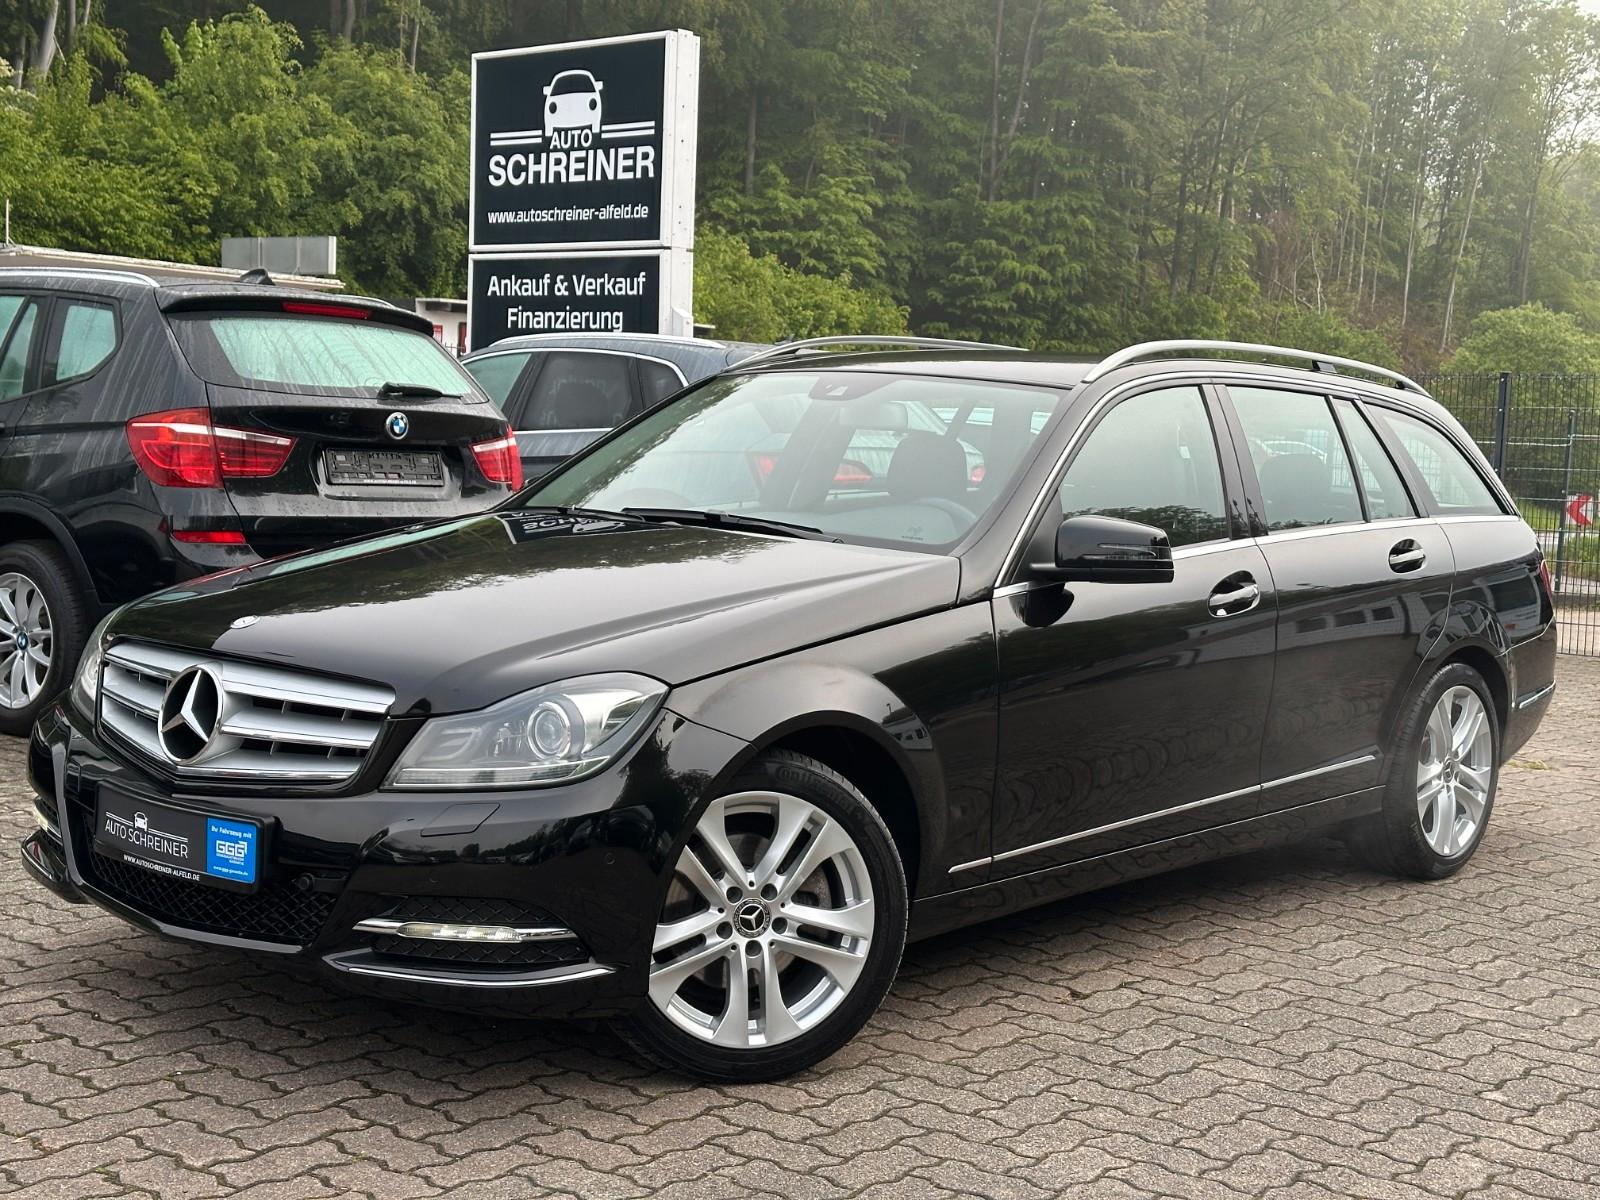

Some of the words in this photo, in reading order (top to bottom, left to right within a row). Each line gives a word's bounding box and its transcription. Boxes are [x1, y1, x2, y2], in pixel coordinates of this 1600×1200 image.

[549, 128, 592, 150] AUTO
[488, 145, 655, 187] SCHREINER
[488, 203, 649, 224] www.autoschreiner-alfeld.de
[487, 273, 550, 297] Ankauf
[554, 274, 569, 296] &
[573, 272, 646, 296] Verkauf
[507, 306, 623, 332] Finanzierung
[104, 819, 127, 839] AUTO
[128, 828, 188, 859] SCHREINER
[216, 840, 246, 858] GGG
